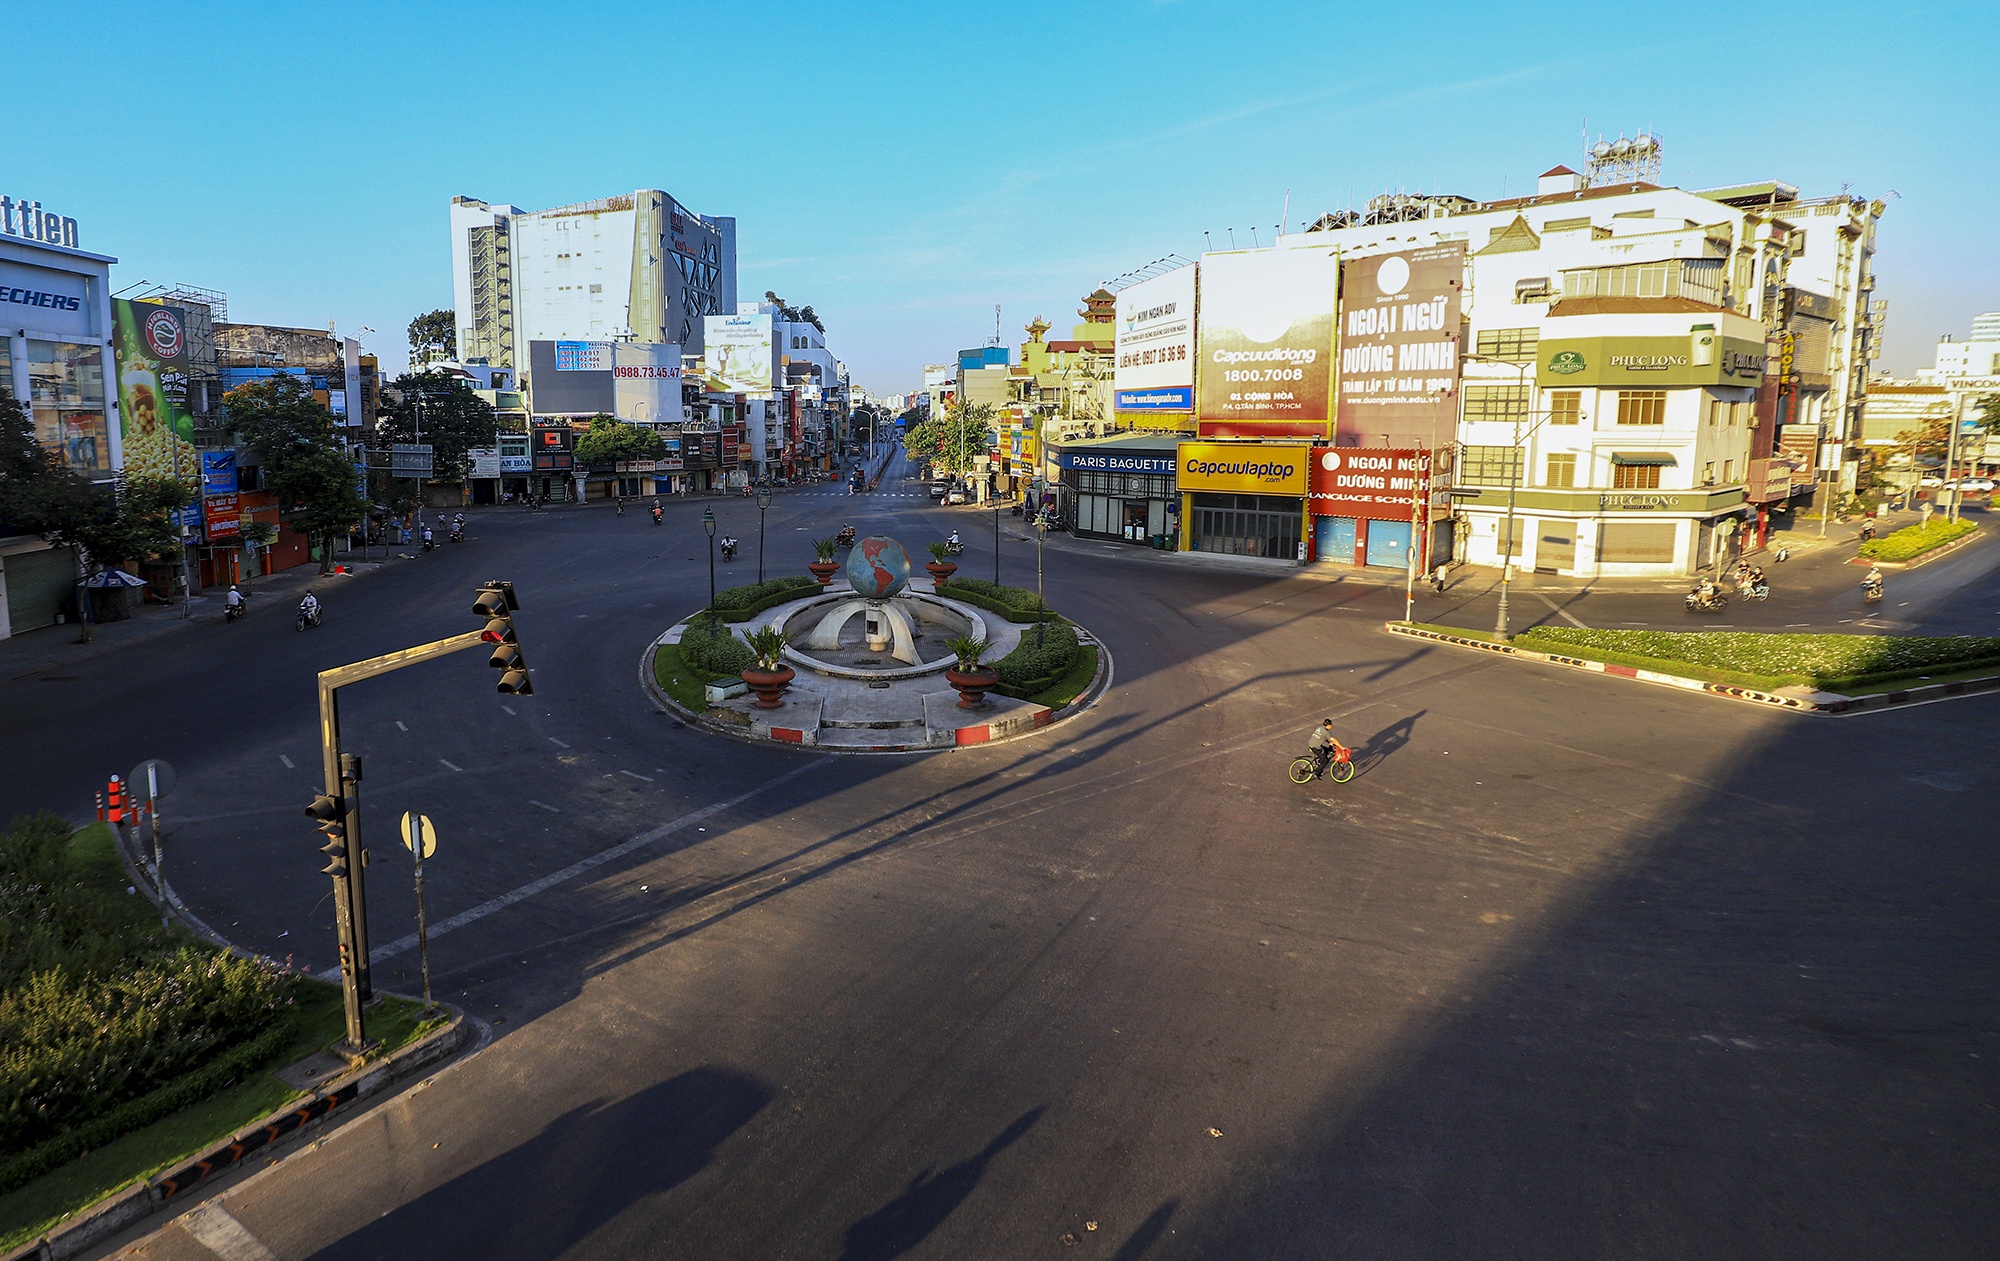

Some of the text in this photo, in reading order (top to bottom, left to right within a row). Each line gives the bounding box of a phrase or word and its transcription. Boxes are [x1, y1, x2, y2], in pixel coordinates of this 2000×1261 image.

[1138, 310, 1148, 322] KIM
[1164, 302, 1177, 316] ADV
[1348, 295, 1448, 340] NGOẠI NGỮ
[148, 312, 180, 334] HIGHLANDS
[153, 342, 179, 355] COFFEE
[1143, 349, 1157, 365] 0917
[1159, 348, 1166, 362] 16
[1168, 346, 1175, 361] 36
[1177, 344, 1186, 360] 96
[1213, 348, 1316, 365] Capcuudidong
[1342, 342, 1455, 374] DƯƠNG MINH
[1650, 355, 1688, 366] LONG
[614, 366, 680, 378] 0988.73.45.47
[1224, 368, 1303, 382] 1800.7008
[1342, 376, 1452, 395] THÀNH LẬP TỪ NĂM 1990
[1952, 380, 2000, 389] VINCOM
[1230, 391, 1294, 402] 01 CỘNG HÒA
[1347, 396, 1440, 404] www.duongminh.edu.vn
[514, 458, 531, 467] HÒA
[1072, 456, 1176, 471] PARIS BAGUETTE
[1186, 459, 1294, 480] Capcuulaptop
[1348, 455, 1430, 472] NGOẠI NGỮ
[1337, 474, 1385, 489] DƯƠNG
[1390, 477, 1429, 491] MINH
[1309, 492, 1428, 505] LANGUAGE SCHOOL
[1641, 496, 1679, 505] LONG
